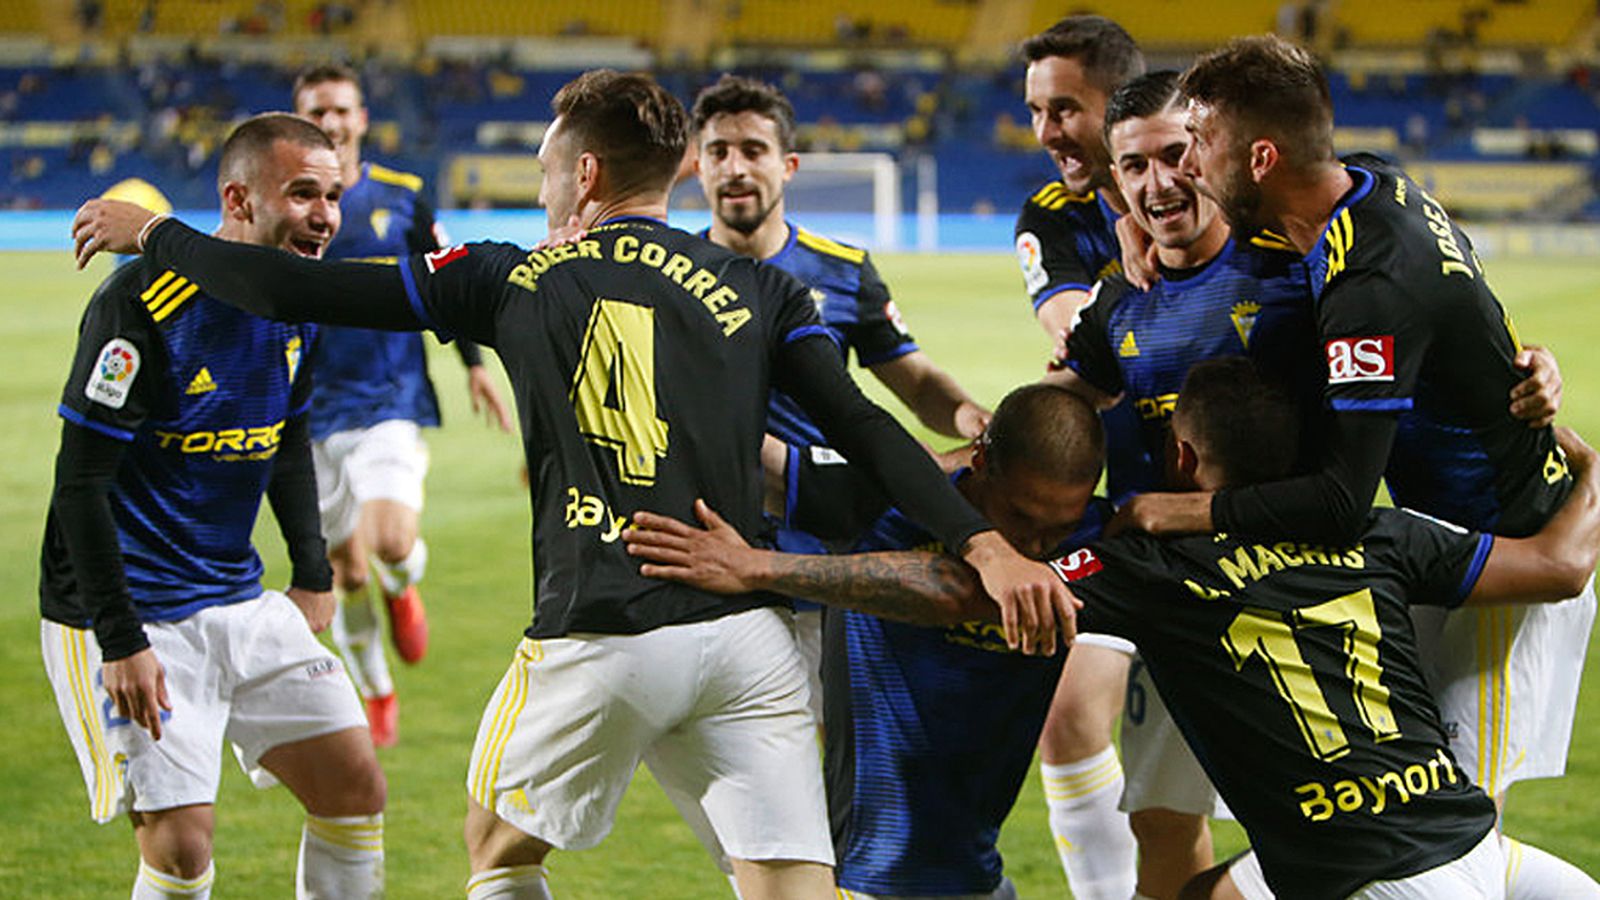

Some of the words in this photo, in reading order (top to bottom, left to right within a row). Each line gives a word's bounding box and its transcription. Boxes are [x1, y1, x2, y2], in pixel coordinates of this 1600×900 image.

[613, 235, 752, 337] CORREA
[569, 297, 669, 487] 4
[1327, 338, 1386, 378] as
[565, 486, 638, 543] Bay
[1220, 587, 1402, 763] 17
